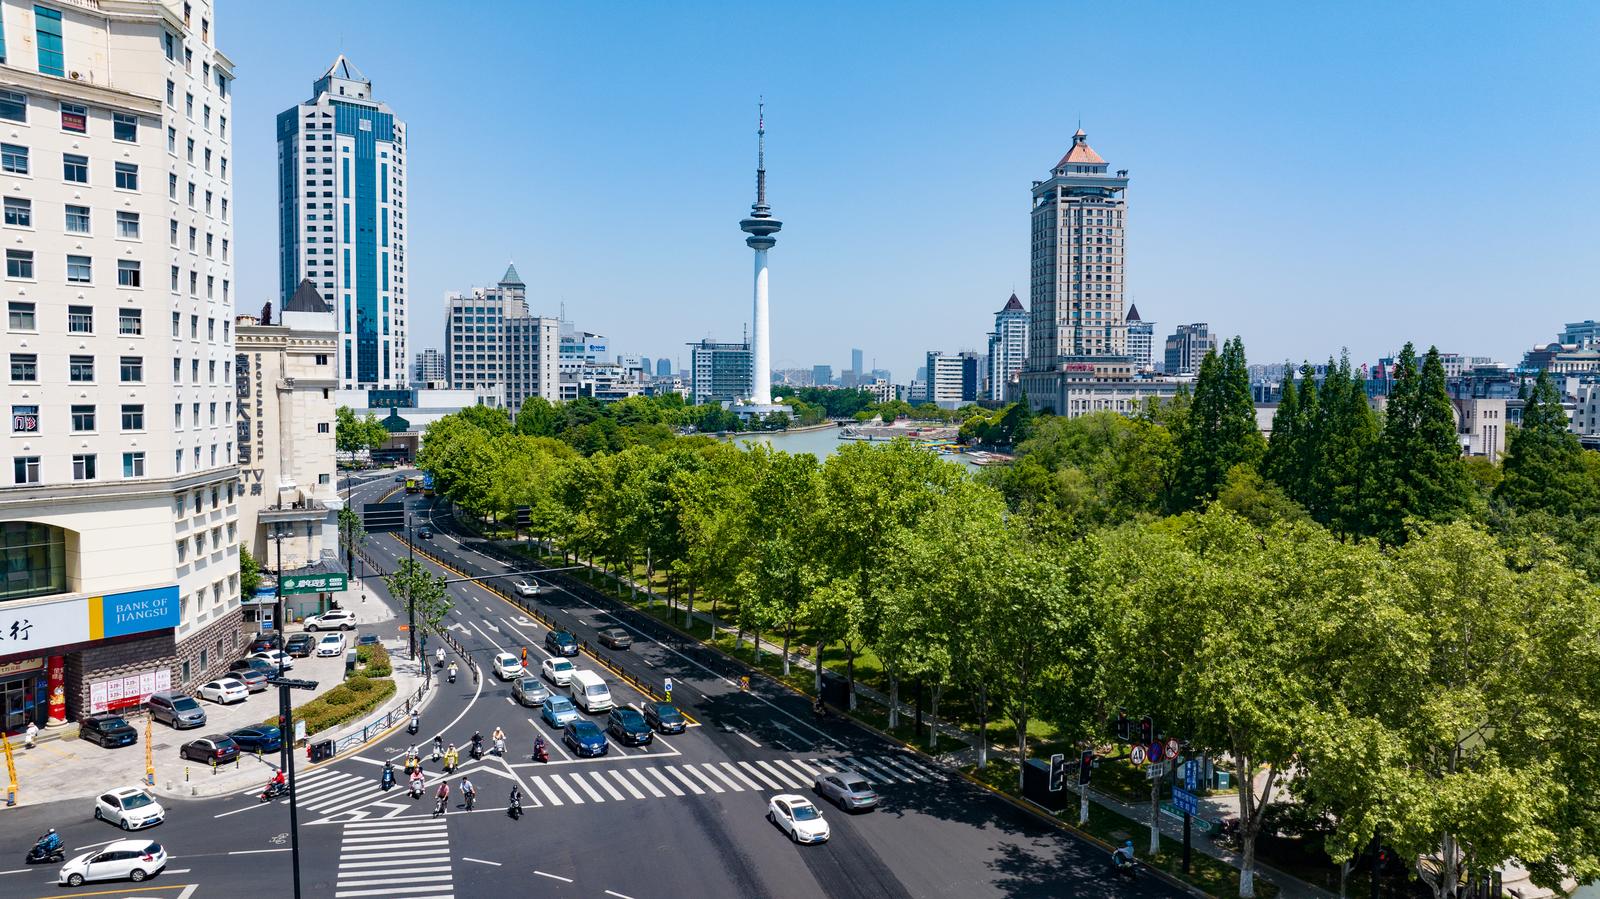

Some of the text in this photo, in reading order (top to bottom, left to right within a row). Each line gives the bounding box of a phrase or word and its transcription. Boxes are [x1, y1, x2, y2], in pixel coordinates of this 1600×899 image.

[255, 353, 264, 462] HAOYUAN HOTEL
[116, 597, 168, 613] BANK OF
[116, 607, 168, 624] JIANGSU
